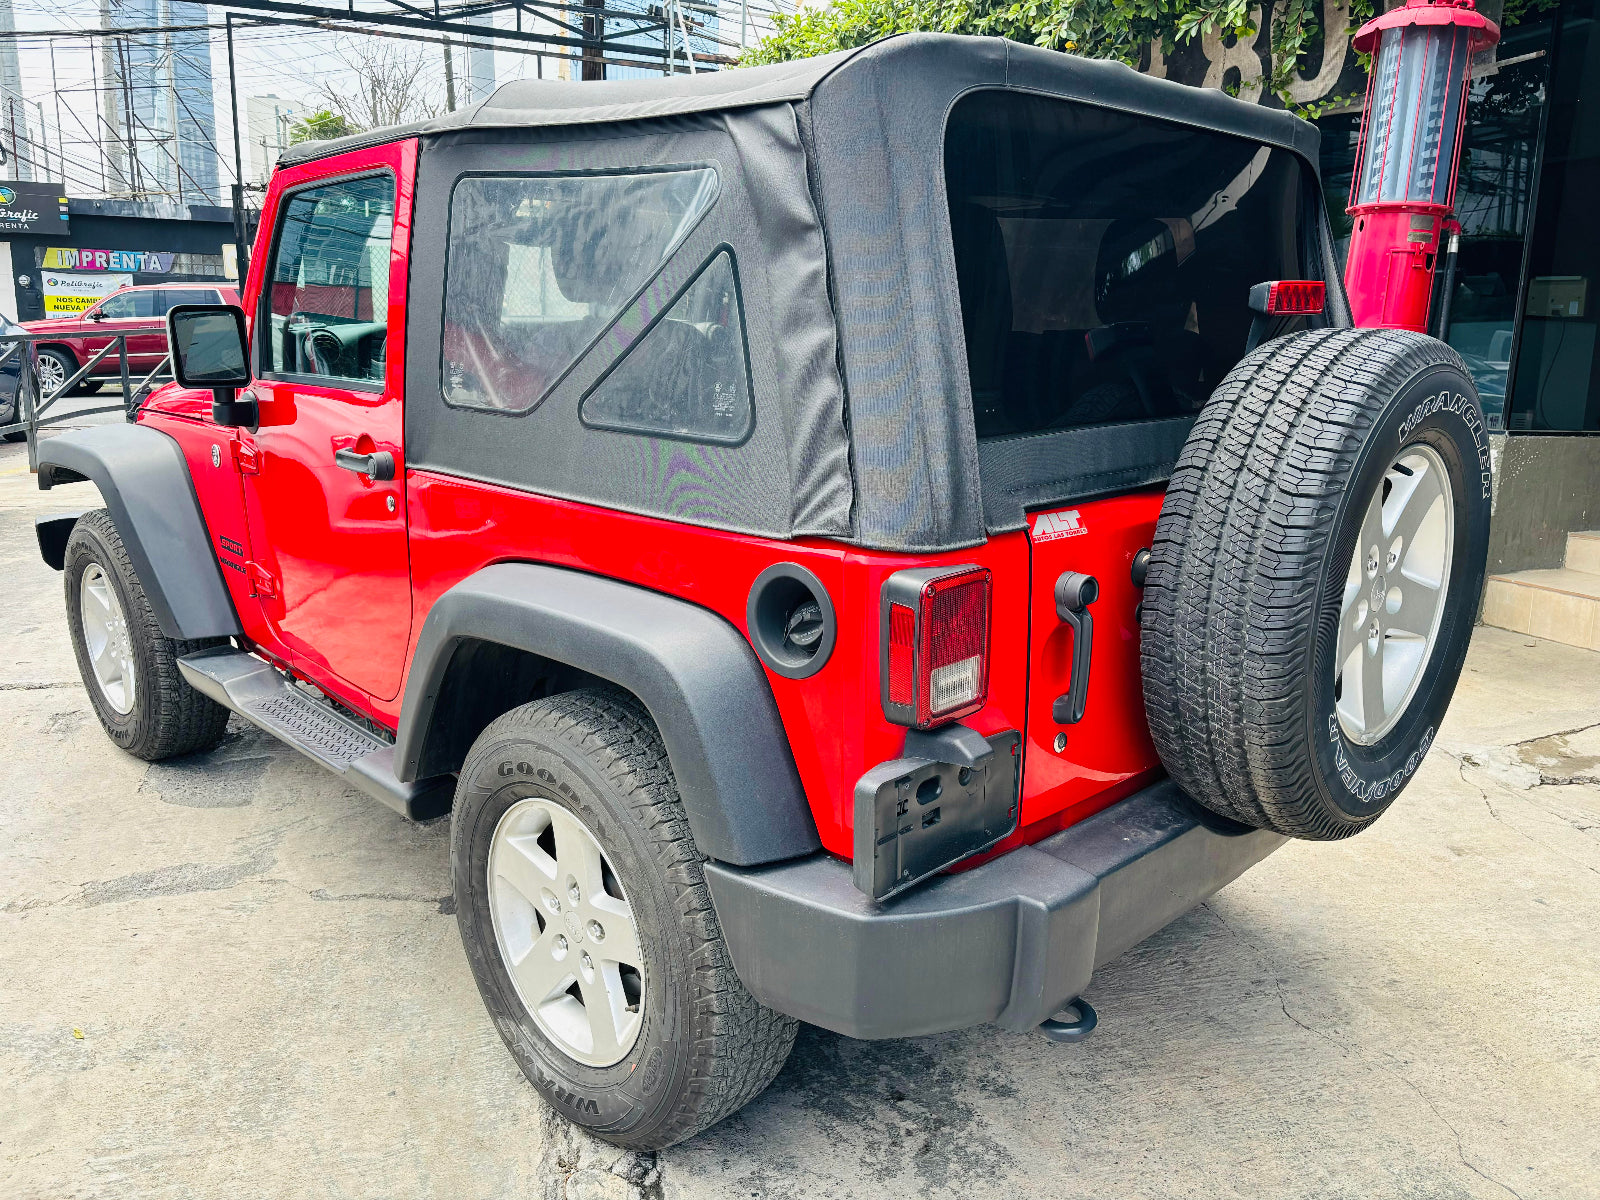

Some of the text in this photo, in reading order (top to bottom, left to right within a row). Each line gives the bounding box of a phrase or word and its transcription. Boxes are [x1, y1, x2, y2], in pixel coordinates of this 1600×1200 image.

[57, 250, 162, 271] IMPRENTA
[1398, 391, 1491, 499] WRANGLER
[1032, 510, 1081, 536] ALT
[221, 537, 243, 555] SPORT
[1328, 713, 1434, 802] GOODYEAR
